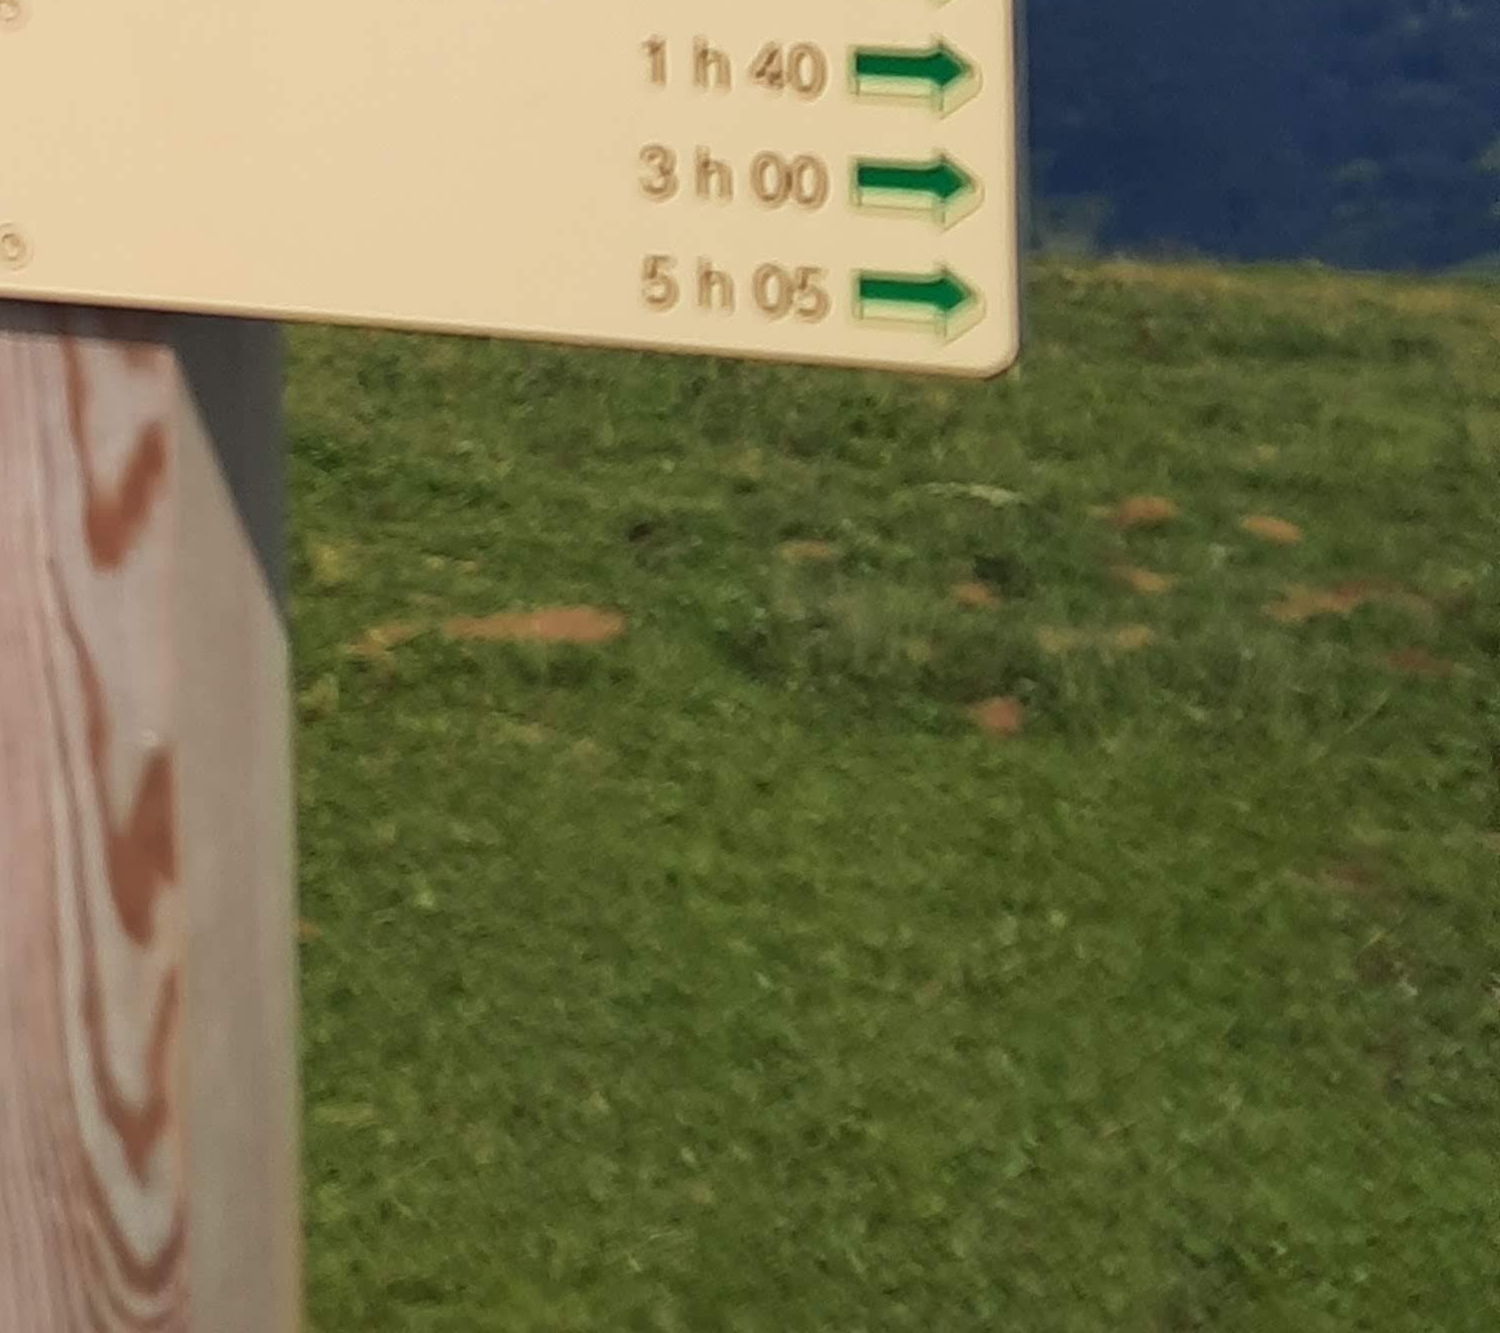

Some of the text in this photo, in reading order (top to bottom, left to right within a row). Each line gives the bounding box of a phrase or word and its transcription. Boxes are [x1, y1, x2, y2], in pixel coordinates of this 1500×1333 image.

[640, 34, 826, 99] 1 h 40
[638, 144, 828, 209] 3 h 00
[642, 254, 830, 323] 5 h 05
